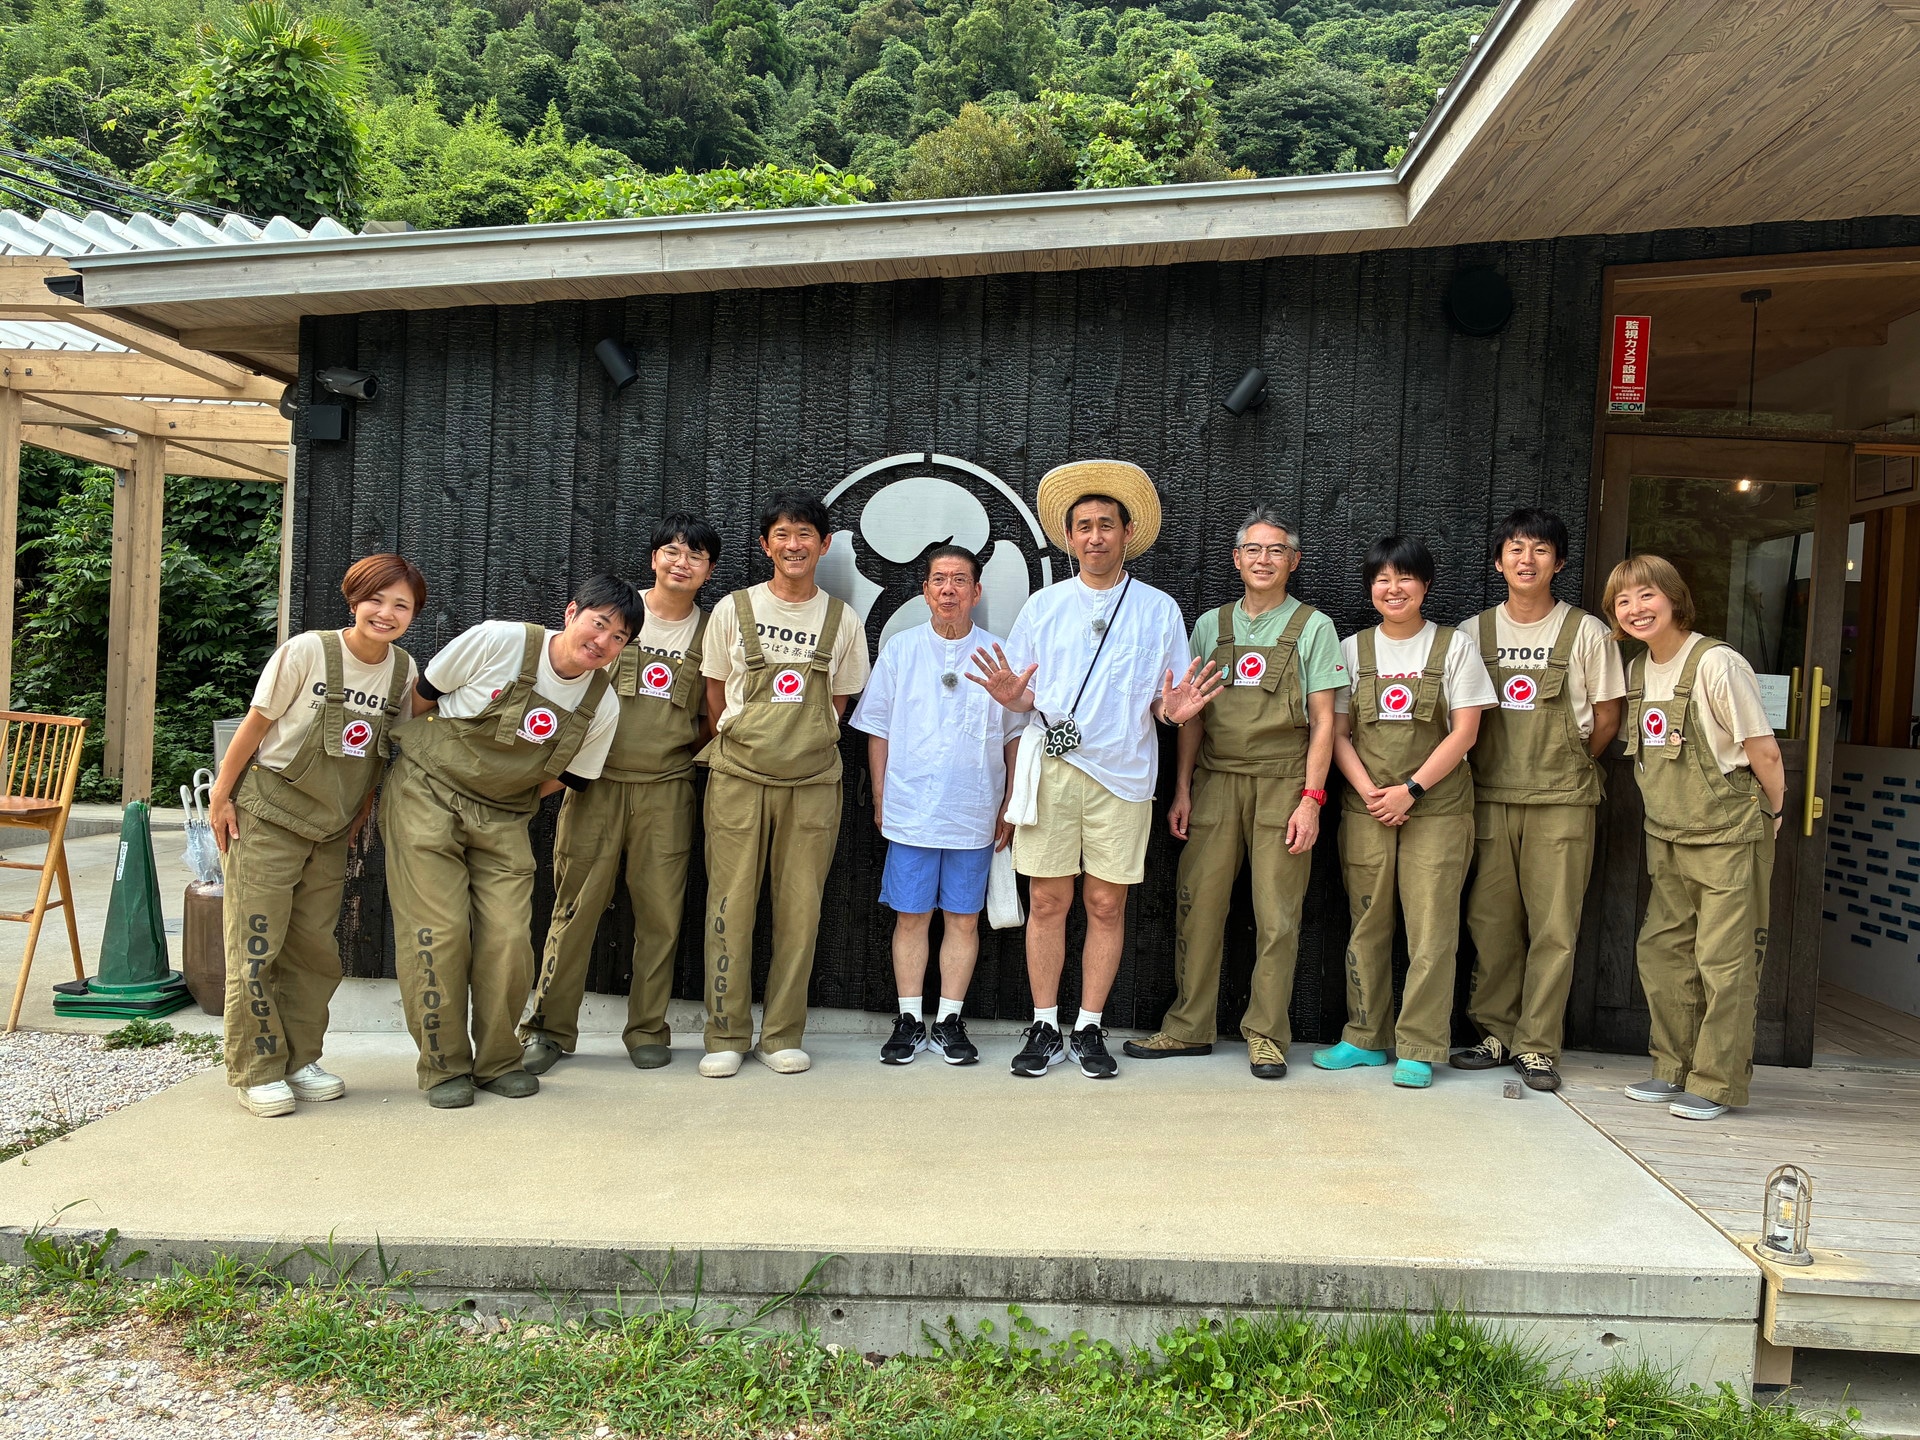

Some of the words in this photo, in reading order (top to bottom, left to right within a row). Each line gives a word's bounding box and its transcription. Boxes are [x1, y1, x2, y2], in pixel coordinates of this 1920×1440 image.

[1622, 320, 1639, 384] 監視カメラ設置
[1611, 402, 1643, 411] SECOM
[739, 623, 817, 646] OTOGI
[312, 682, 388, 711] GTOGI
[247, 914, 278, 1055] GOTOGIN
